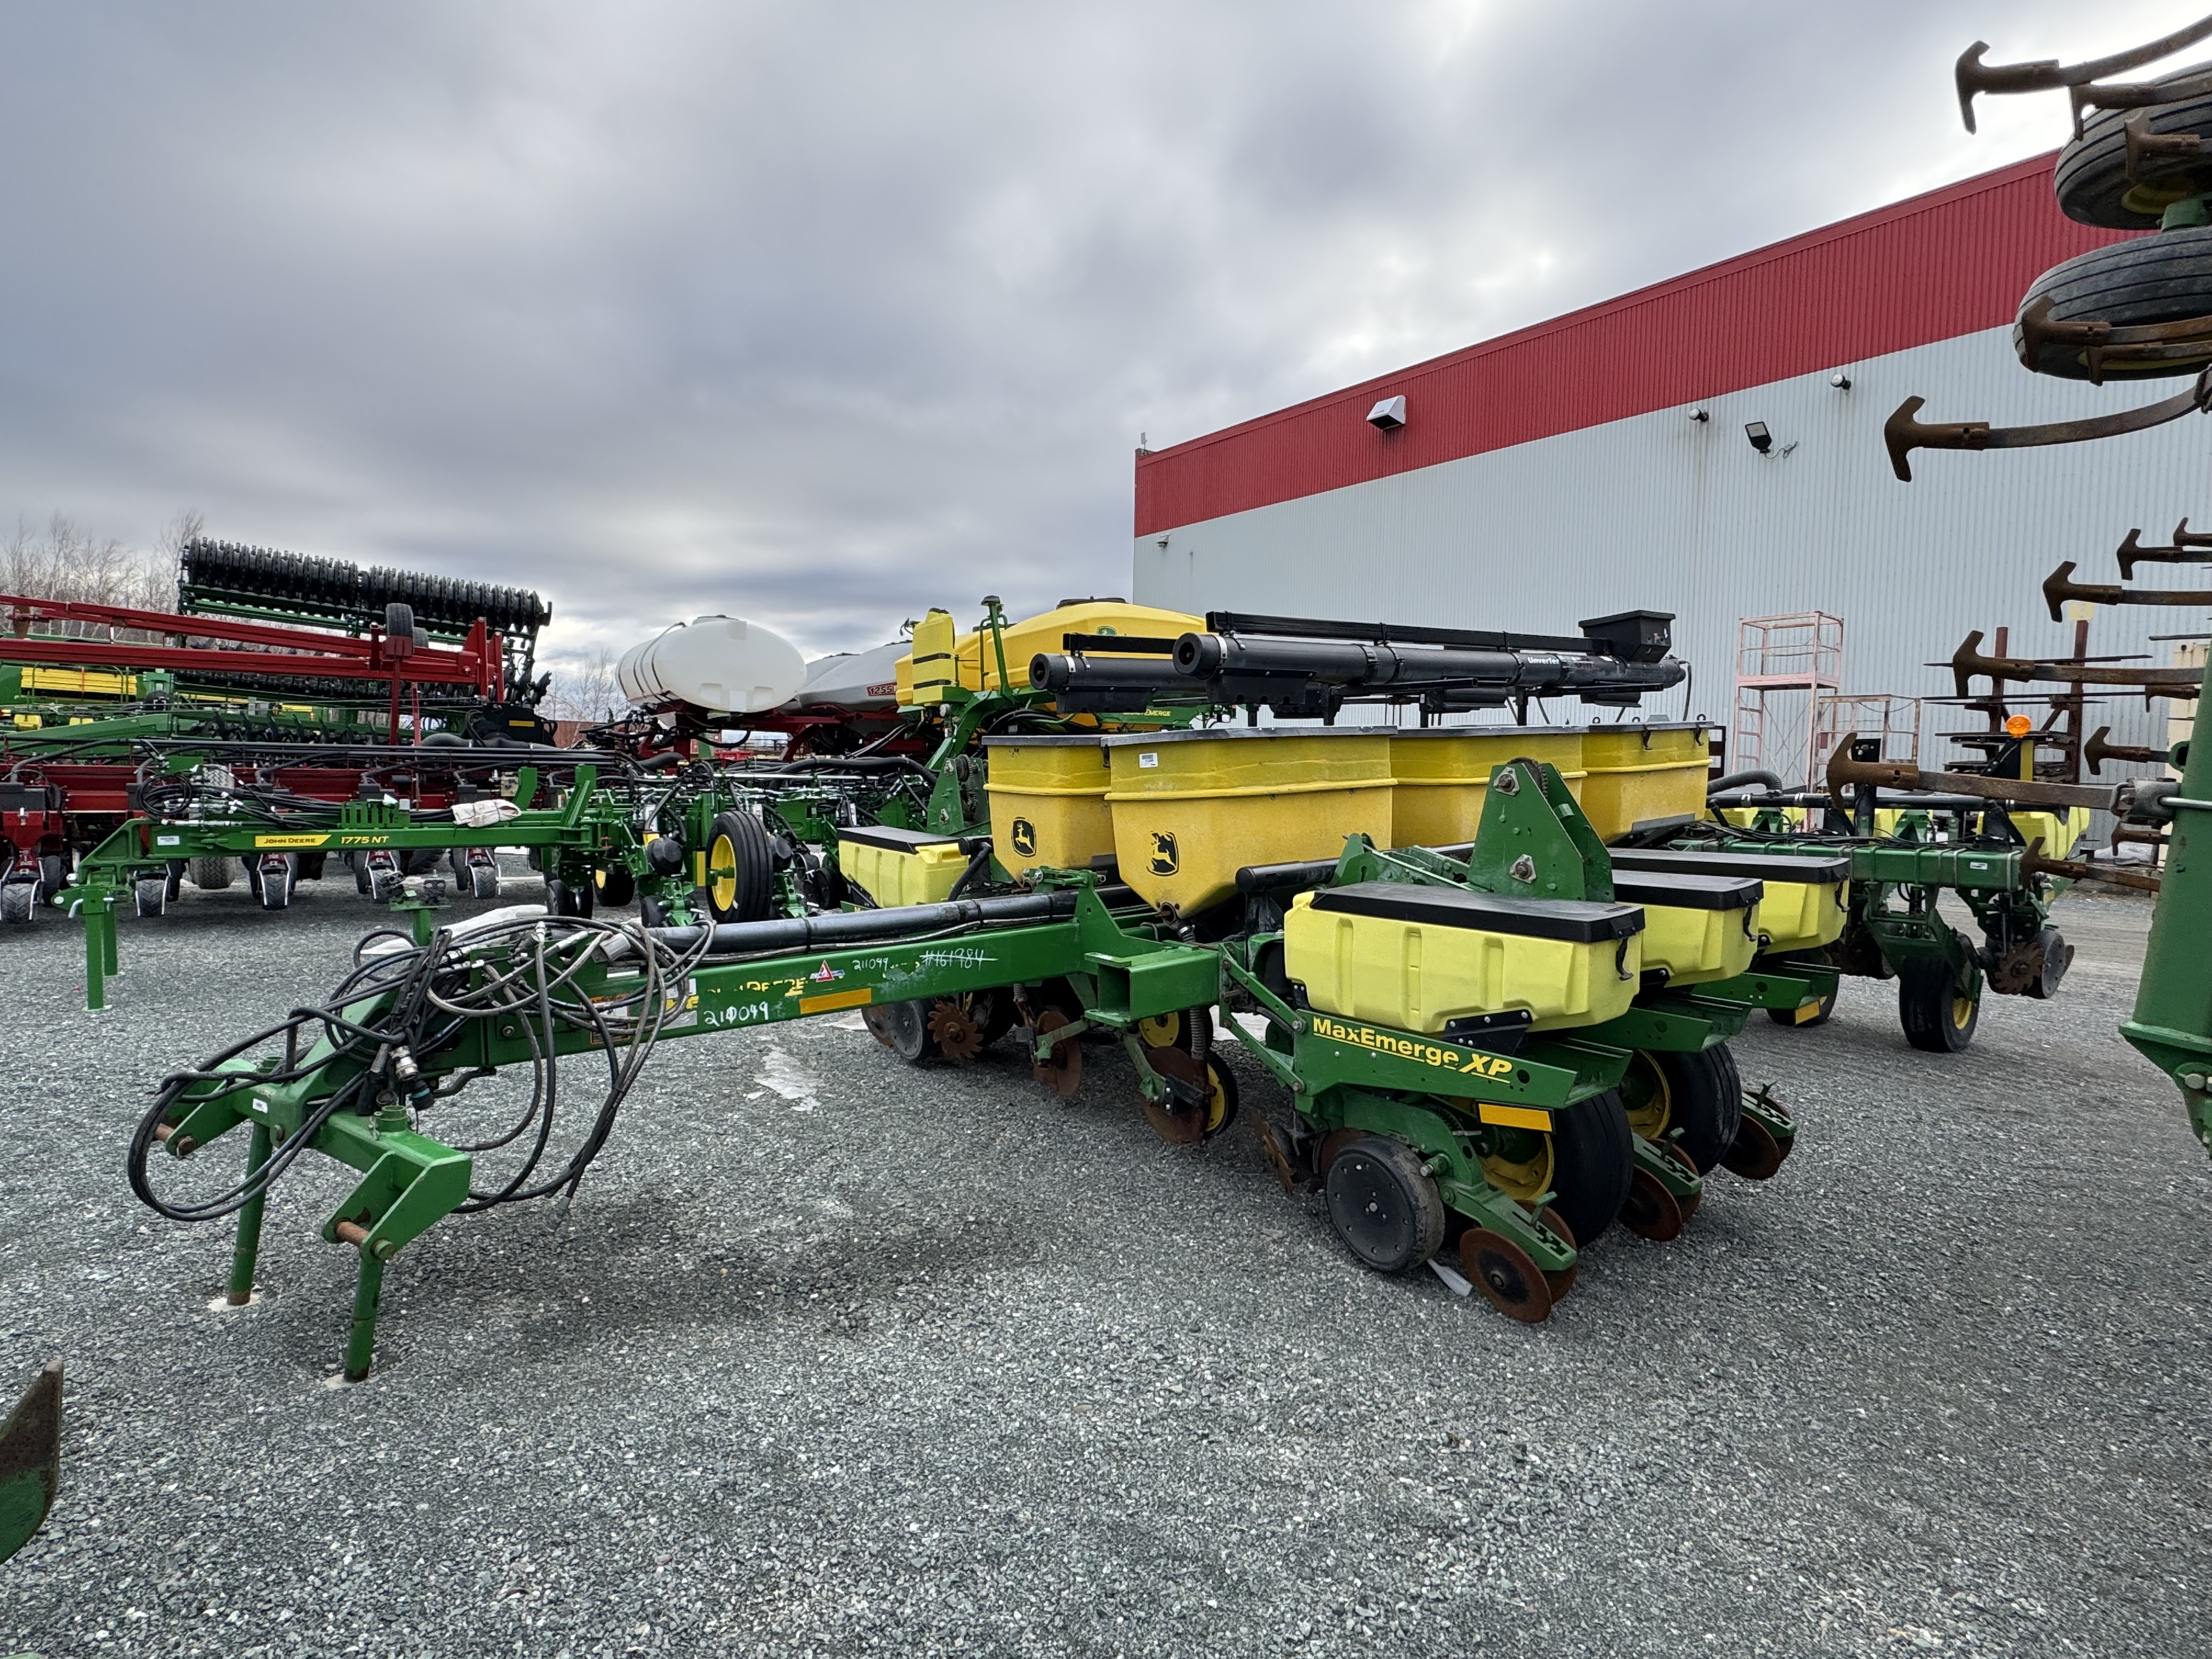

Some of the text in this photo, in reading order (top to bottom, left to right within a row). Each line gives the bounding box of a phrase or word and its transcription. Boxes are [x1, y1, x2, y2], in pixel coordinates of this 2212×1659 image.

[1527, 656, 1559, 664] Unverfer
[341, 836, 370, 844] 1775
[371, 836, 390, 844] NT
[1313, 1016, 1513, 1076] MaxEmerge XP
